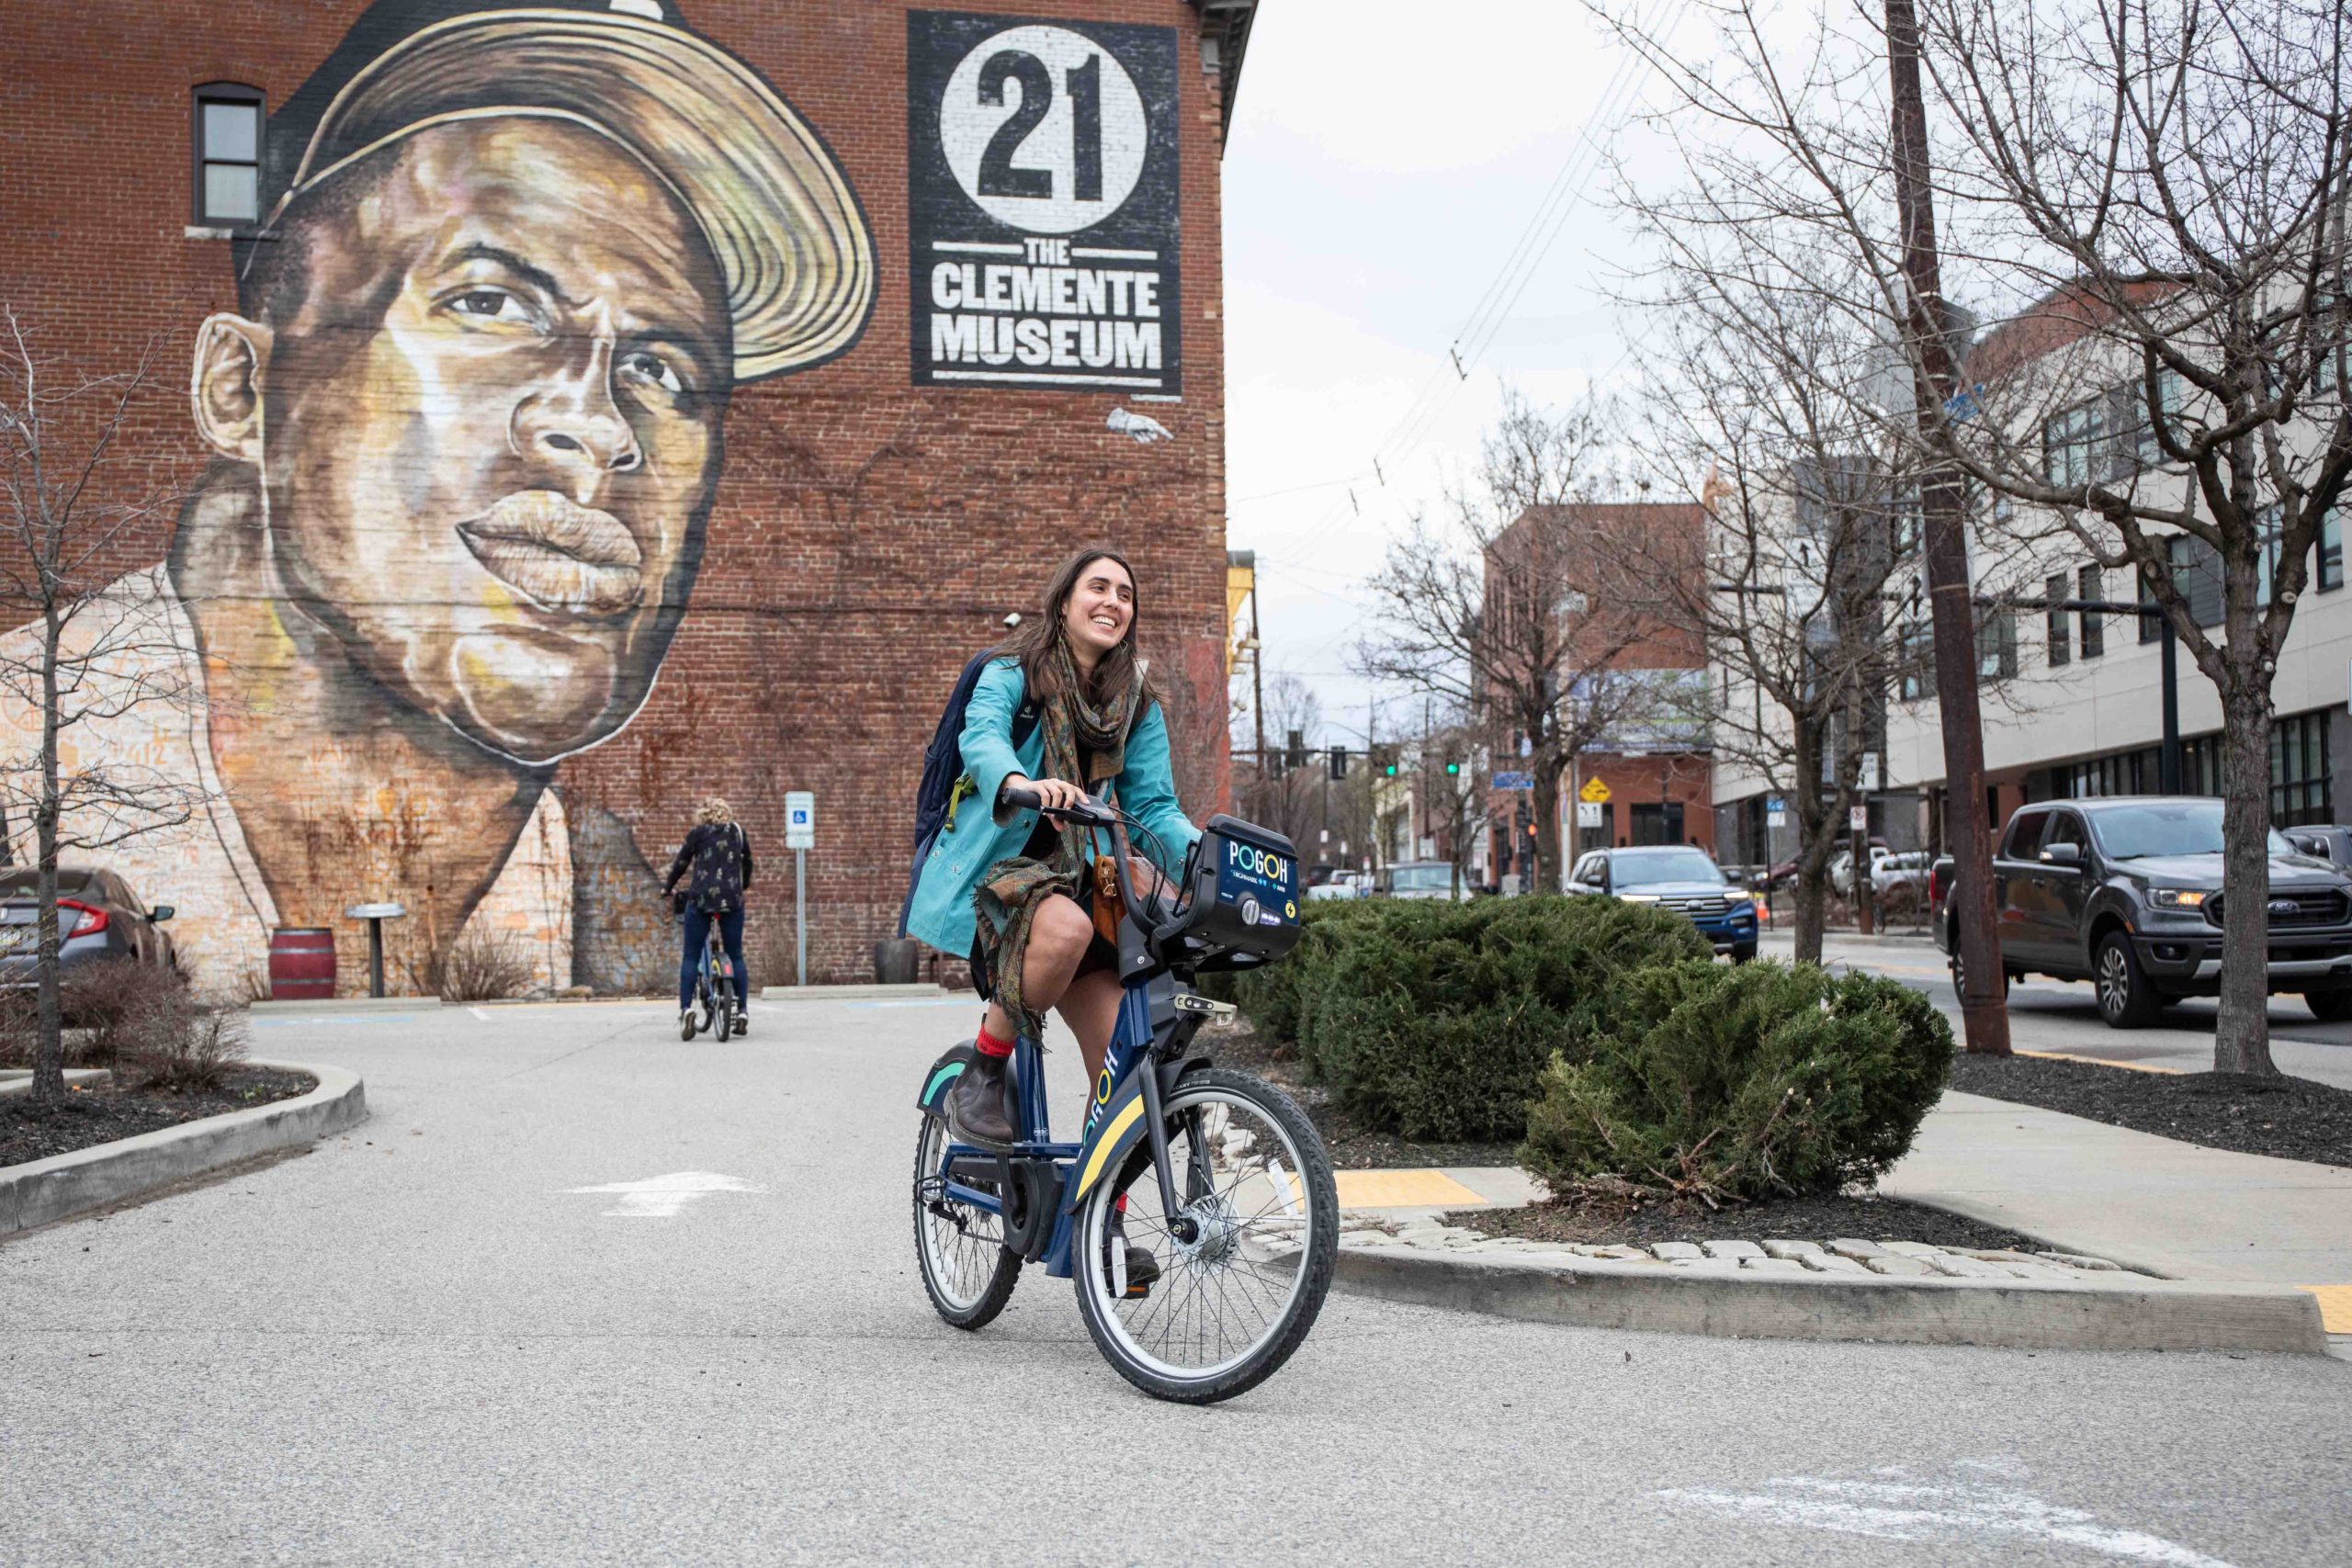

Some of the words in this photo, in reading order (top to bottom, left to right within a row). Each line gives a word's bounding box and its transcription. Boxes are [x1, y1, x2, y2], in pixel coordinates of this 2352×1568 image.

[978, 49, 1102, 201] 21
[1024, 238, 1070, 265] THE
[932, 262, 1160, 317] CLEMENTE
[932, 313, 1161, 369] MUSEUM
[1230, 841, 1287, 884] POGOH
